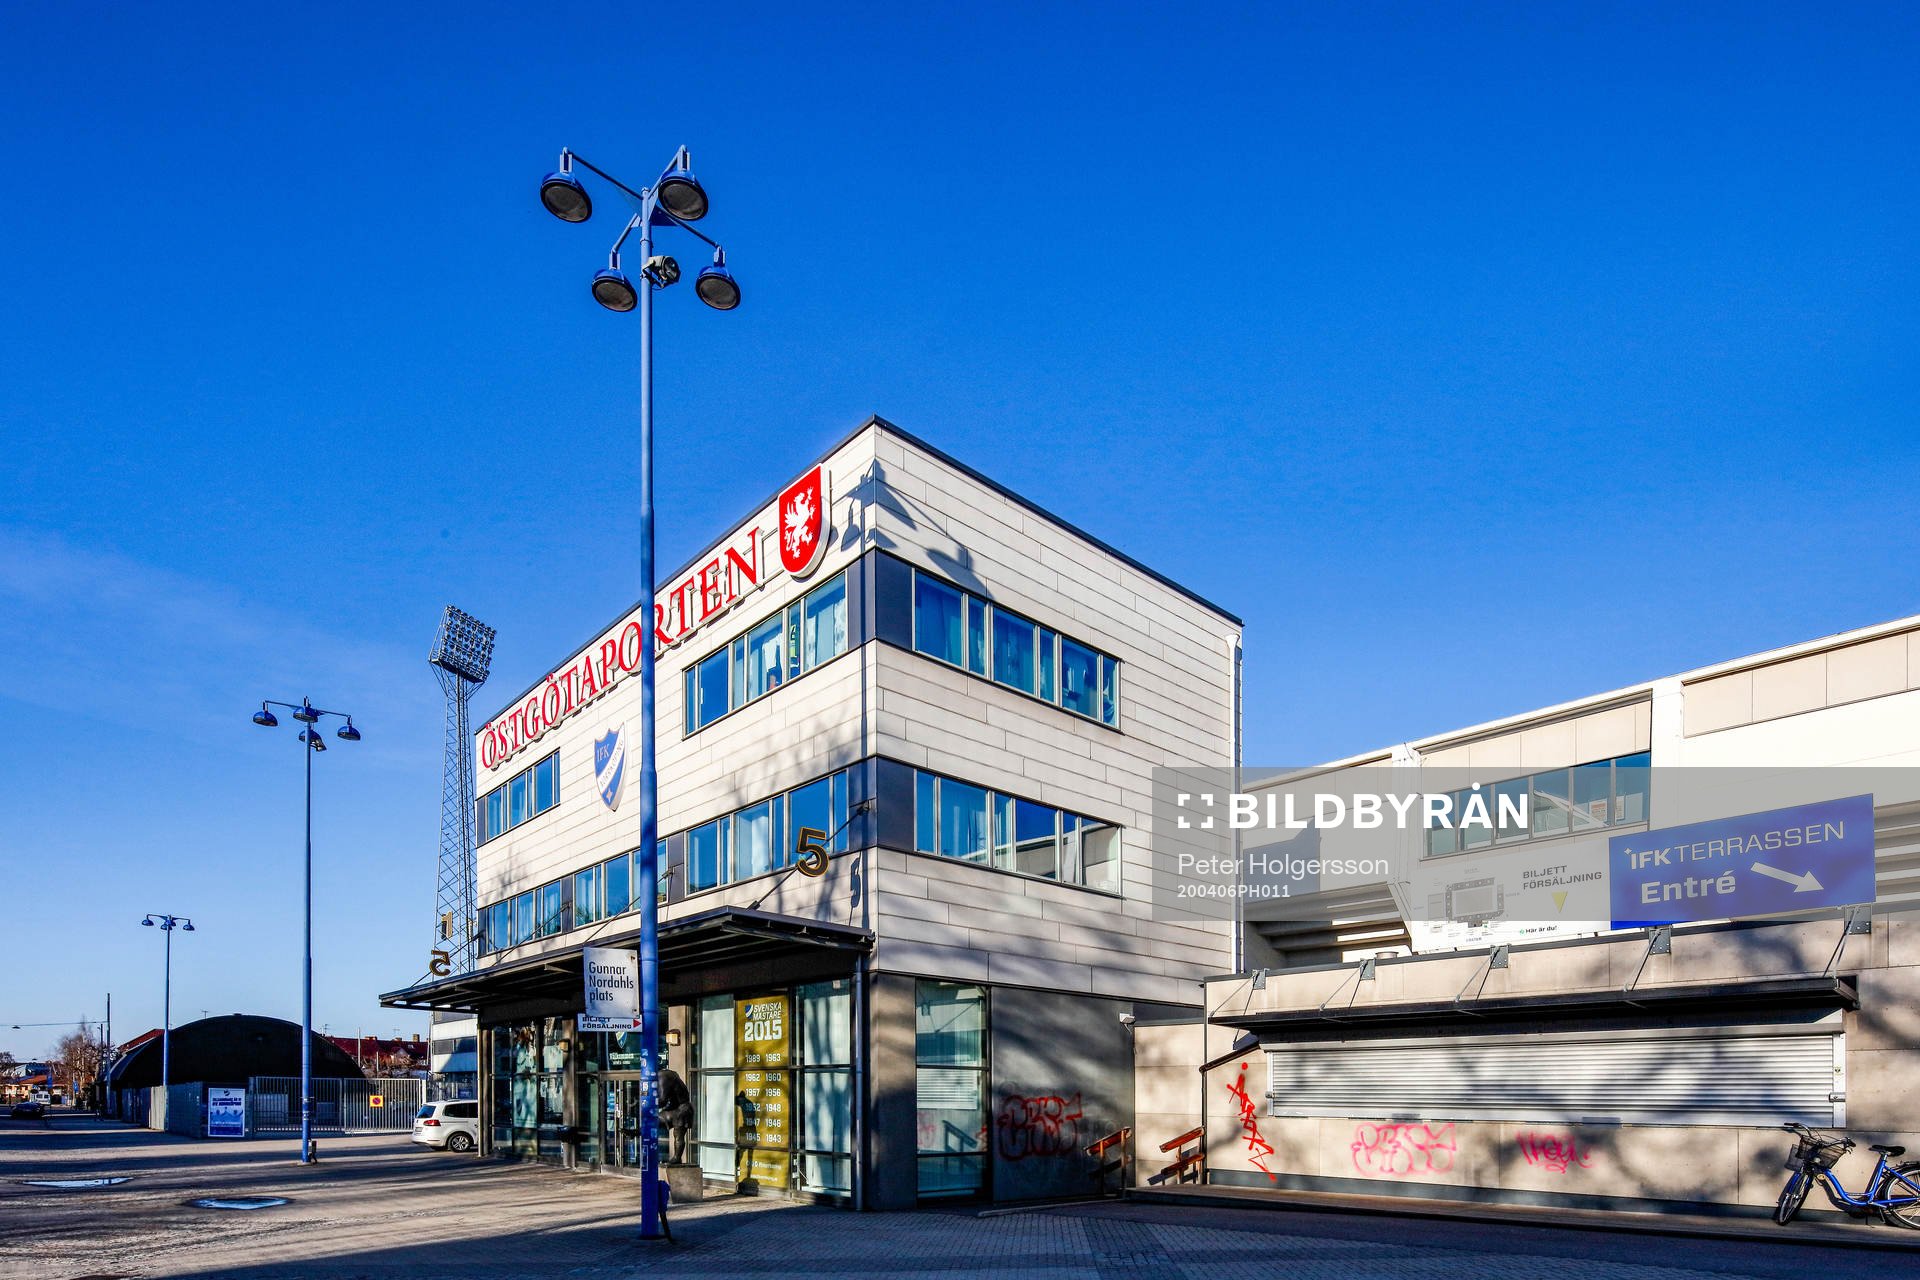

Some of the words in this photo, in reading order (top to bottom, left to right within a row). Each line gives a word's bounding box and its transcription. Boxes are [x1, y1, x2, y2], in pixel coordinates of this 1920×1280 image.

[481, 526, 764, 770] ÖSTGÖTAPORTEN
[597, 743, 610, 763] IFK
[797, 827, 830, 877] 5
[1522, 865, 1568, 879] BILJETT
[1522, 871, 1602, 890] FÖRSÄLJNING
[1641, 870, 1737, 904] Entré
[588, 961, 627, 975] Gunnar
[588, 975, 634, 989] Nordahls
[589, 987, 614, 1004] plats
[752, 1001, 782, 1013] SVENSKA
[744, 1019, 783, 1042] 2015
[765, 1053, 781, 1062] 1963
[765, 1072, 782, 1082] 1960
[745, 1088, 760, 1097] 1957
[765, 1088, 781, 1097] 1956
[765, 1103, 782, 1112] 1948
[765, 1134, 782, 1144] 1943
